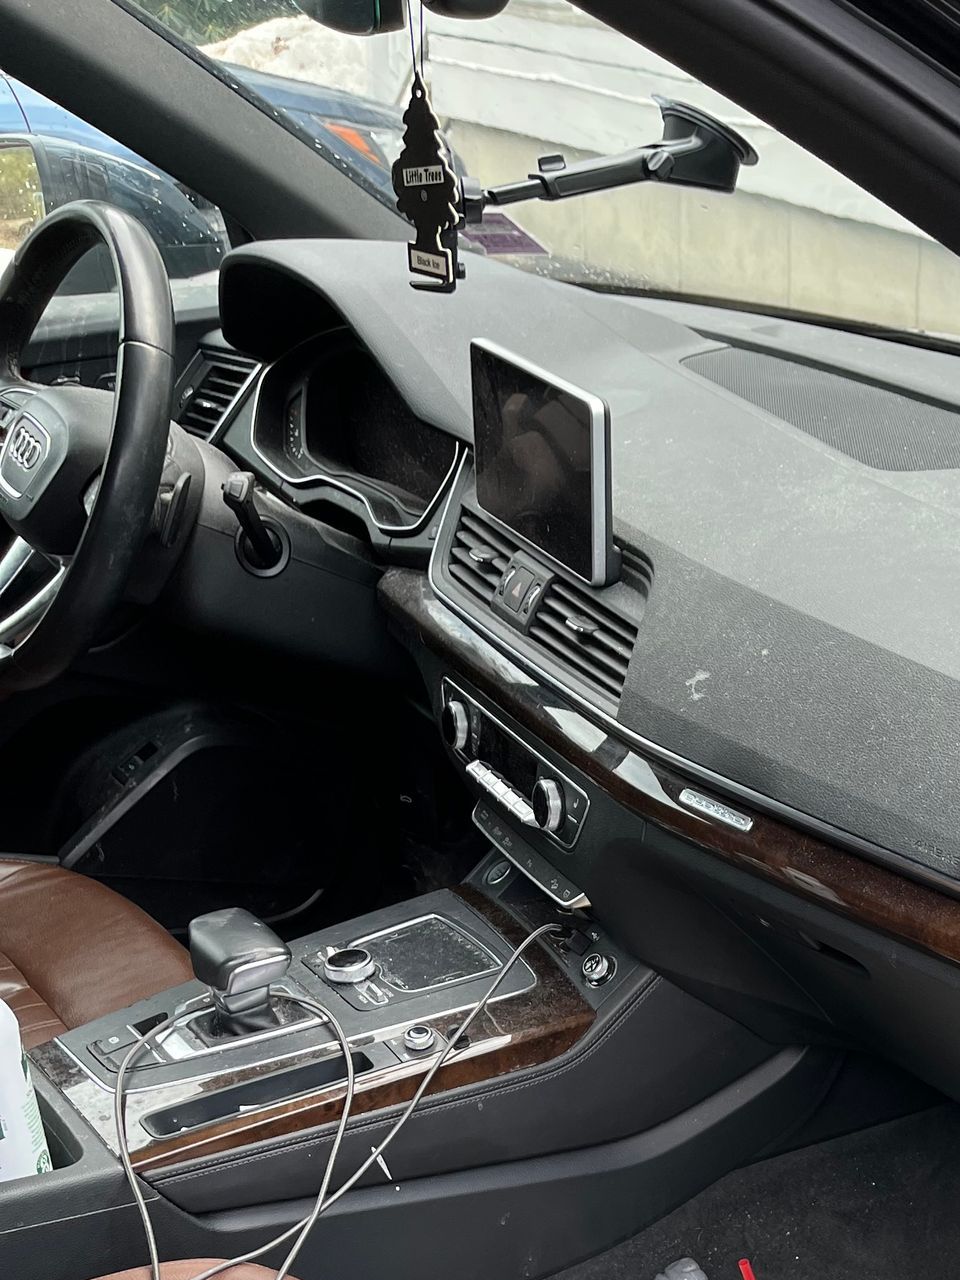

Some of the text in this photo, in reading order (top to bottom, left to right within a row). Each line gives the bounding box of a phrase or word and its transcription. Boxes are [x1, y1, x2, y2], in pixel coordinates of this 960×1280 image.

[405, 168, 442, 185] Little Trees
[416, 255, 441, 270] Black Ice
